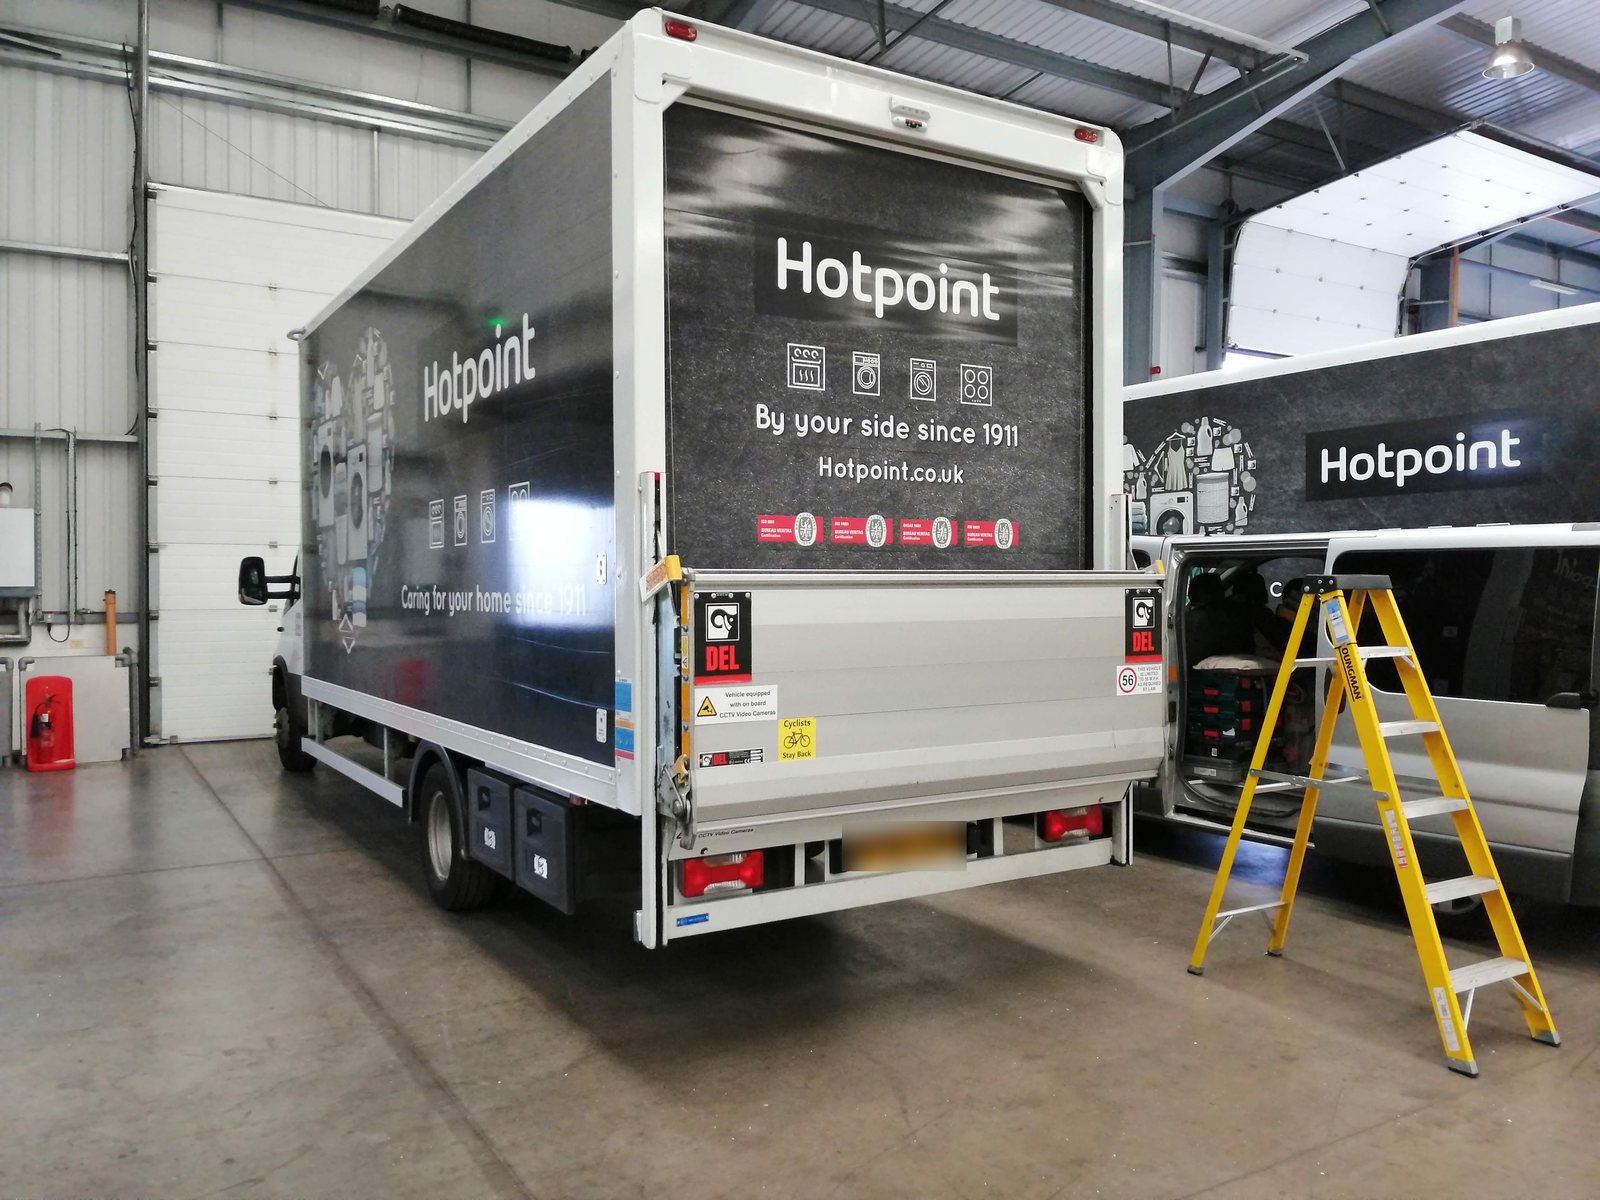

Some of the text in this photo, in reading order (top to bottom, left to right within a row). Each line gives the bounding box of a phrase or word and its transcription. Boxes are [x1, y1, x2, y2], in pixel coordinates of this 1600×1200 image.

[777, 237, 1001, 321] Hotpoint
[424, 312, 536, 424] Hotpoint
[756, 403, 1019, 447] By your side since 1911
[819, 456, 964, 484] Hotpoint.co.uk
[1321, 428, 1521, 488] Hotpoint
[401, 583, 587, 617] Caring for your home since 1911
[1132, 631, 1155, 652] DEL
[705, 645, 740, 671] DEL
[1122, 674, 1134, 686] 56
[1341, 647, 1362, 700] OUNGMAN
[746, 690, 771, 698] equipped
[784, 719, 811, 729] Cyclists
[797, 750, 811, 758] Back
